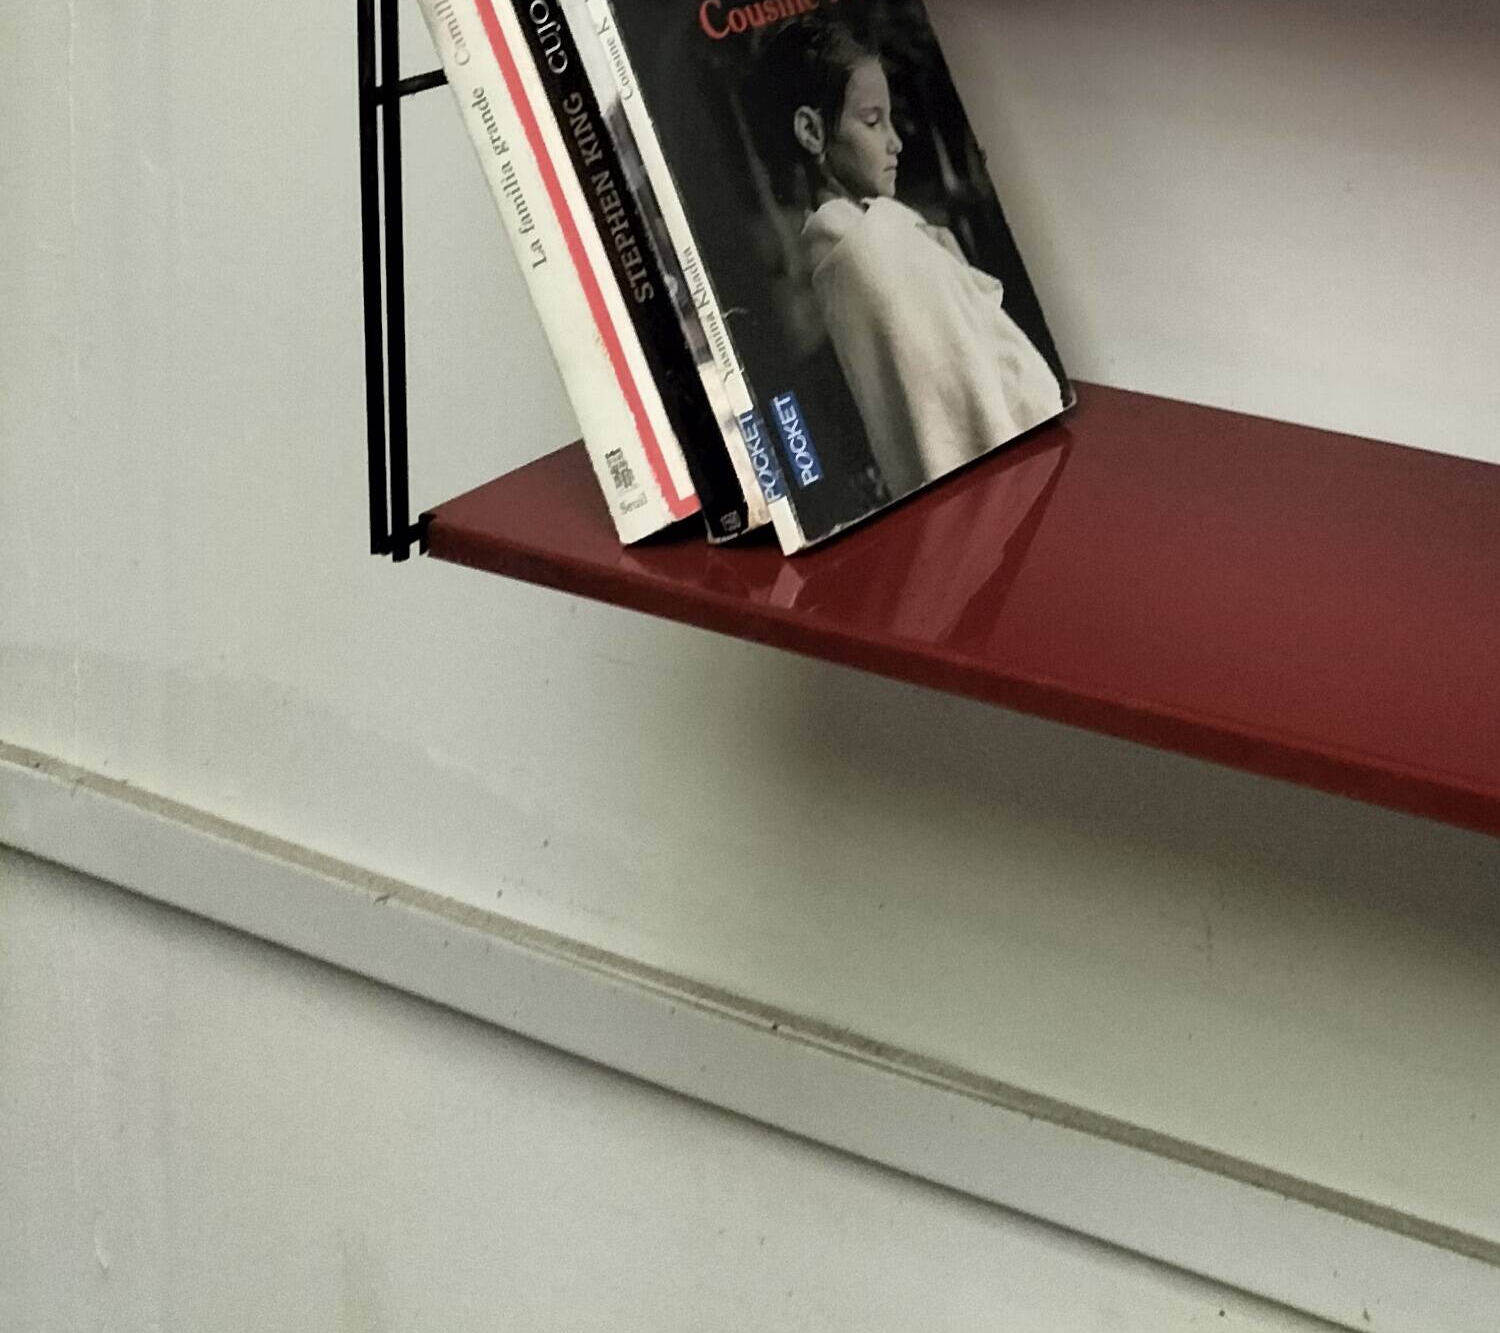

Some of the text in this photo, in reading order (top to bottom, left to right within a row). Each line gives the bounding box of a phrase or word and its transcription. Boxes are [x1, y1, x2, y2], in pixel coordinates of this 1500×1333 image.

[606, 38, 634, 101] Cousine
[471, 86, 547, 270] La familia grande
[562, 91, 655, 304] STEPHEN KING
[682, 245, 734, 383] Yasmina Khadra
[739, 412, 782, 502] POCKET
[773, 395, 819, 487] POCKET
